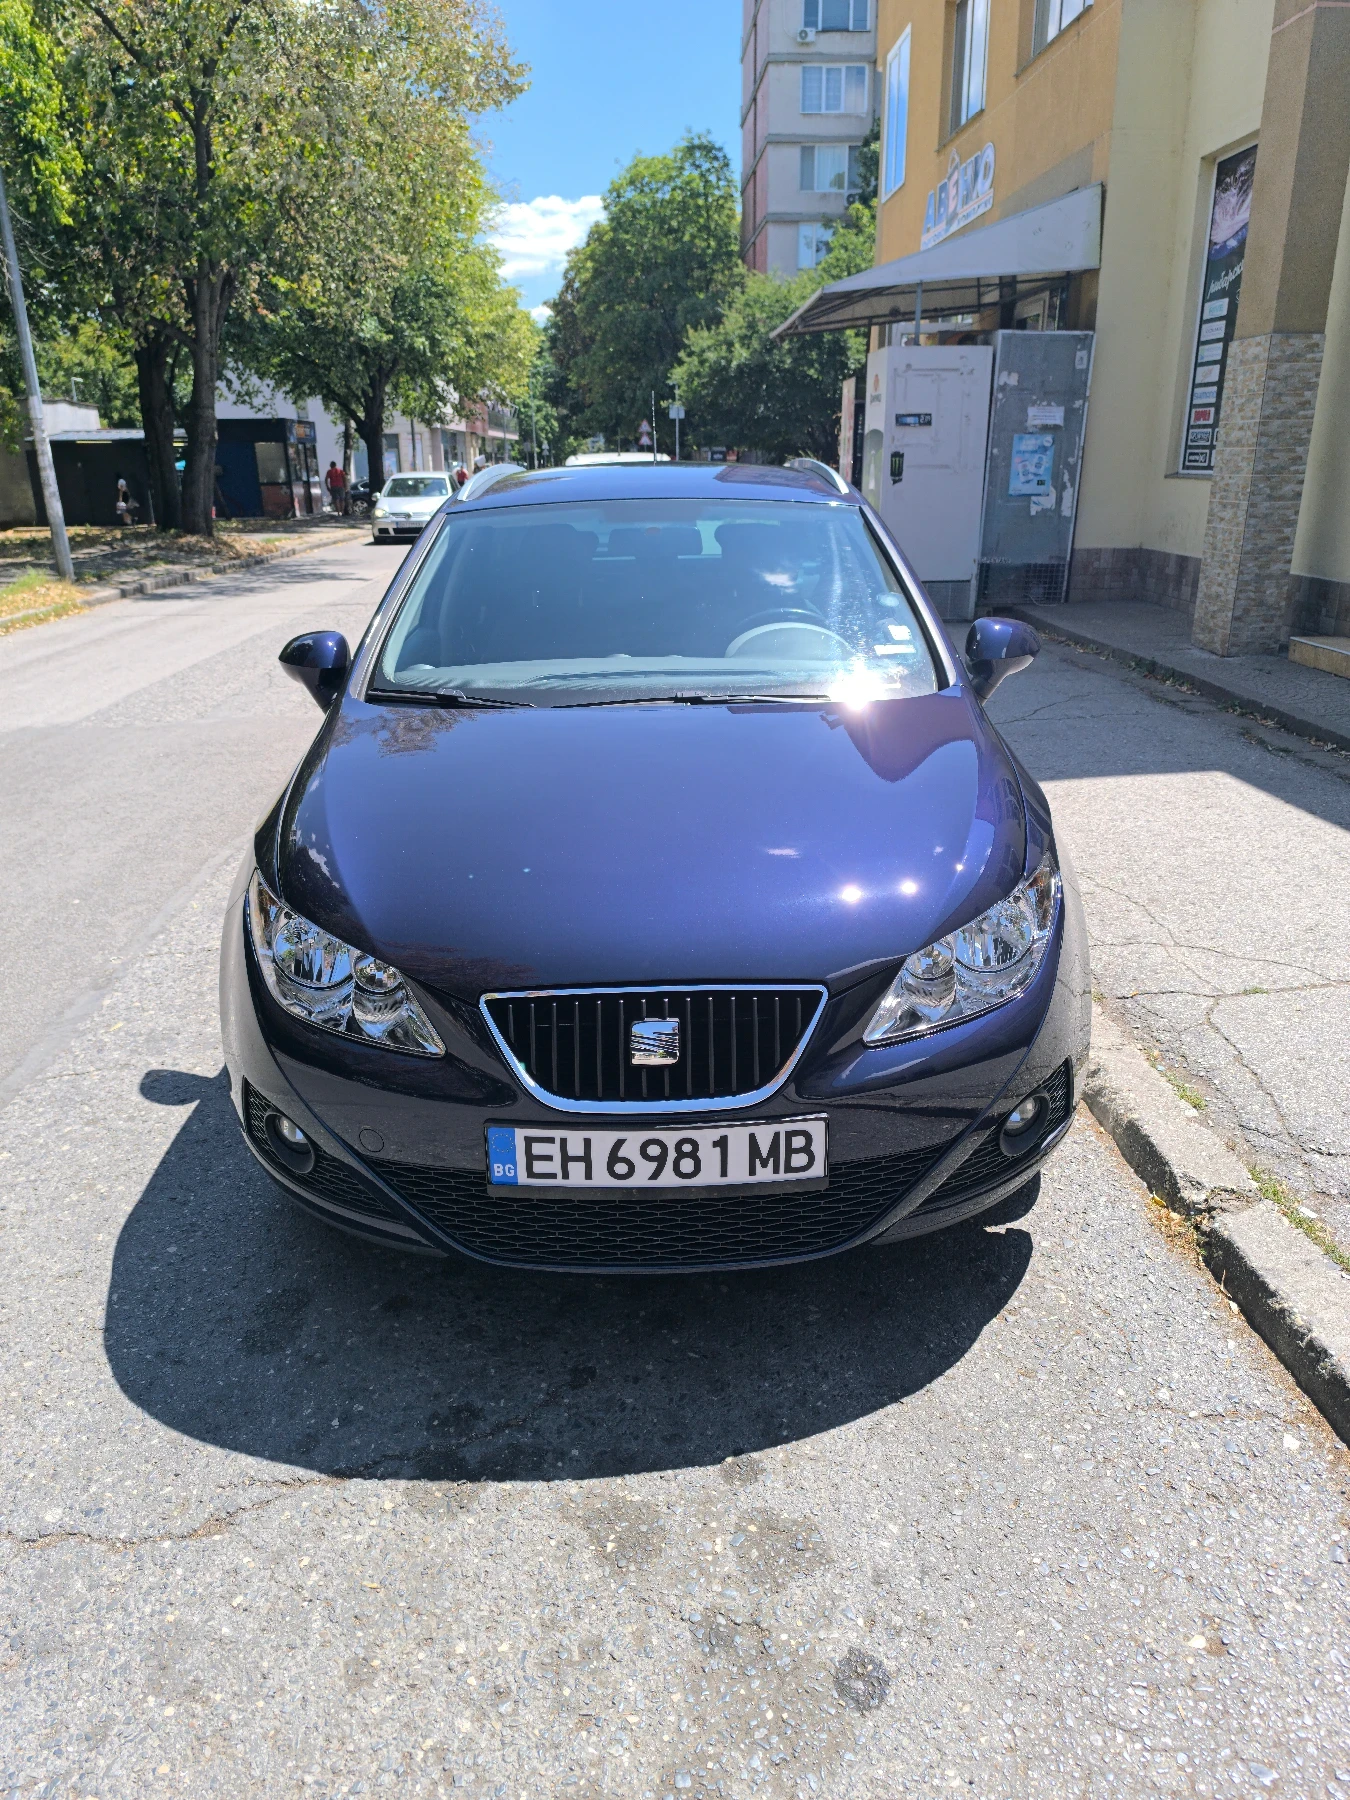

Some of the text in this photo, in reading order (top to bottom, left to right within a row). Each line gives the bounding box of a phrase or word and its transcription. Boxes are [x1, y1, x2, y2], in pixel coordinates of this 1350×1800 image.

[922, 142, 995, 236] АВЕНЮ
[493, 1129, 816, 1181] BG EH 6981 MB
